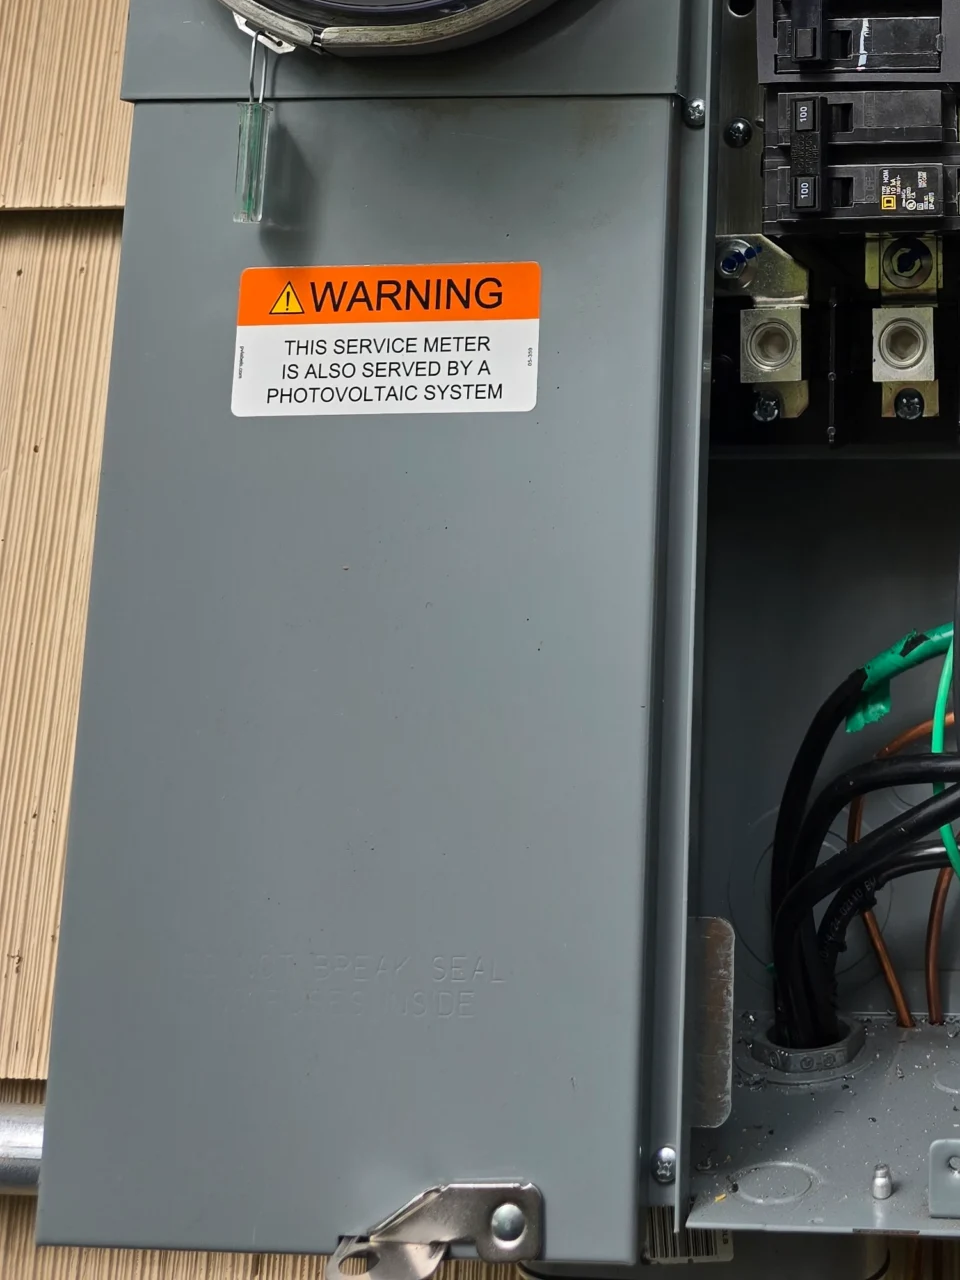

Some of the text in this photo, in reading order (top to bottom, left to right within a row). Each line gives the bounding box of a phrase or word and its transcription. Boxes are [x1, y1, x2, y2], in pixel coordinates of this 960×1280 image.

[798, 106, 808, 122] 100
[799, 181, 809, 198] 100
[310, 277, 503, 312] WARNING
[284, 336, 490, 356] THIS SERVICE METER
[282, 360, 490, 380] IS ALSO SERVED BY A
[267, 384, 502, 404] PHOTOVOLTAIC SYSTEM
[432, 955, 508, 984] SEAL
